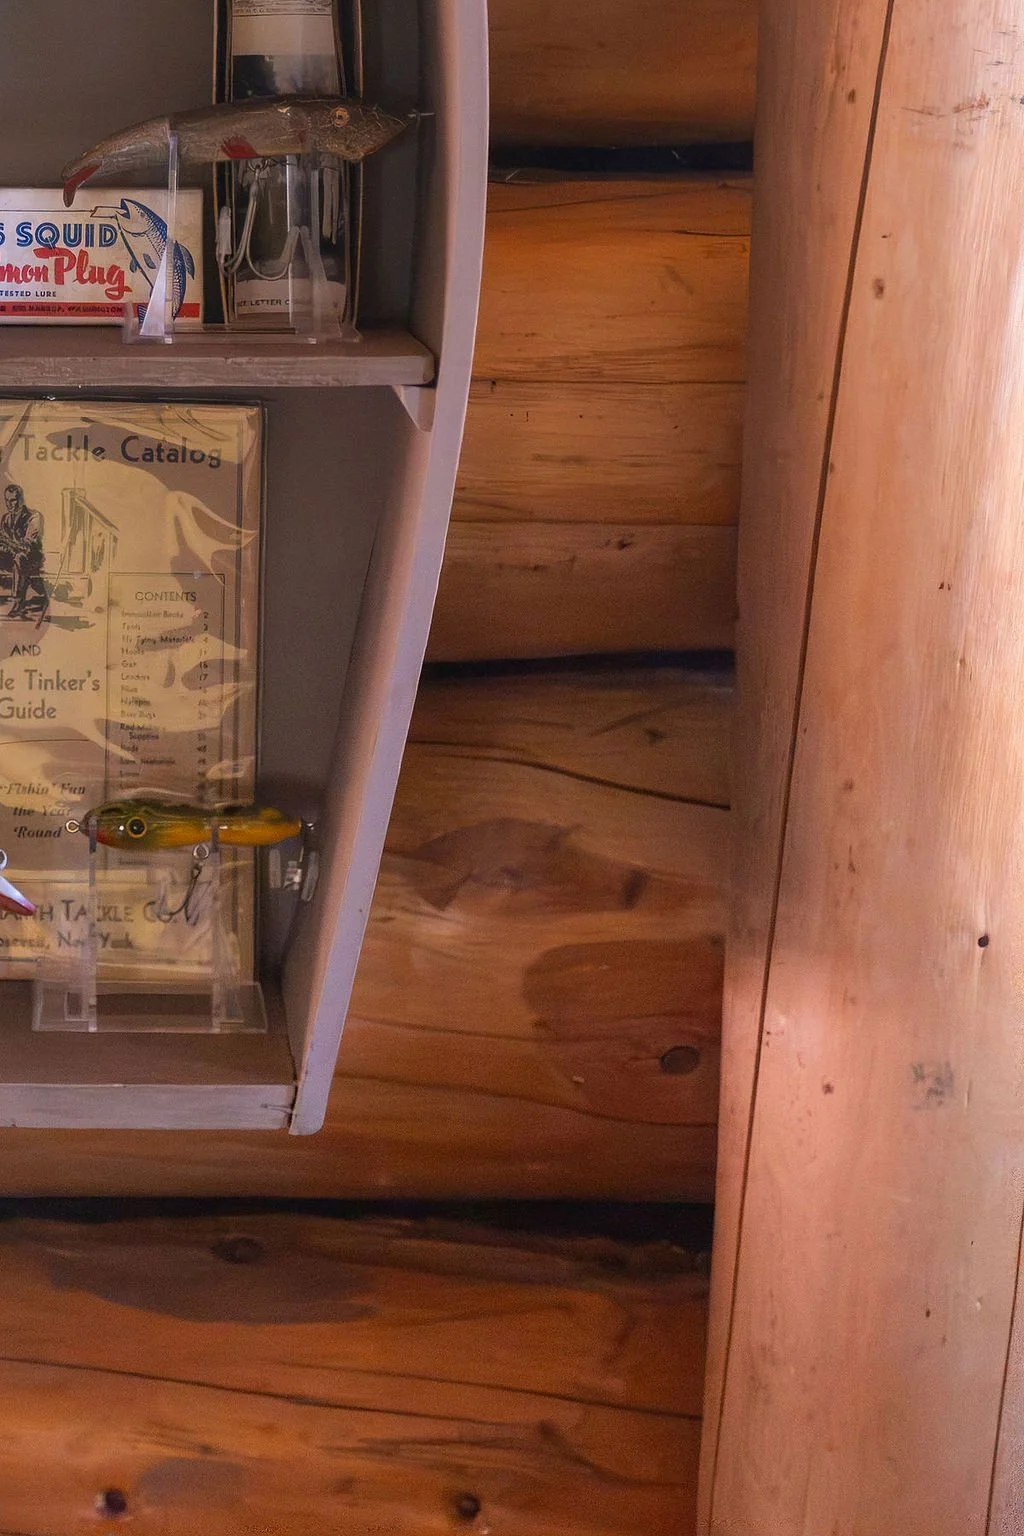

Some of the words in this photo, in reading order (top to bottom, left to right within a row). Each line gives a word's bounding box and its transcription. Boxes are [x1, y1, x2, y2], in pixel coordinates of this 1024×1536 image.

[15, 221, 118, 249] SQUID
[33, 247, 133, 301] Plug
[250, 298, 281, 306] LETTER
[18, 434, 106, 462] Tackle
[120, 435, 222, 469] Catalog
[135, 591, 197, 603] CONTENTS
[9, 644, 41, 657] AND
[24, 669, 101, 691] Tinker's
[61, 782, 86, 795] Fun
[13, 806, 35, 817] the
[40, 806, 72, 817] Year
